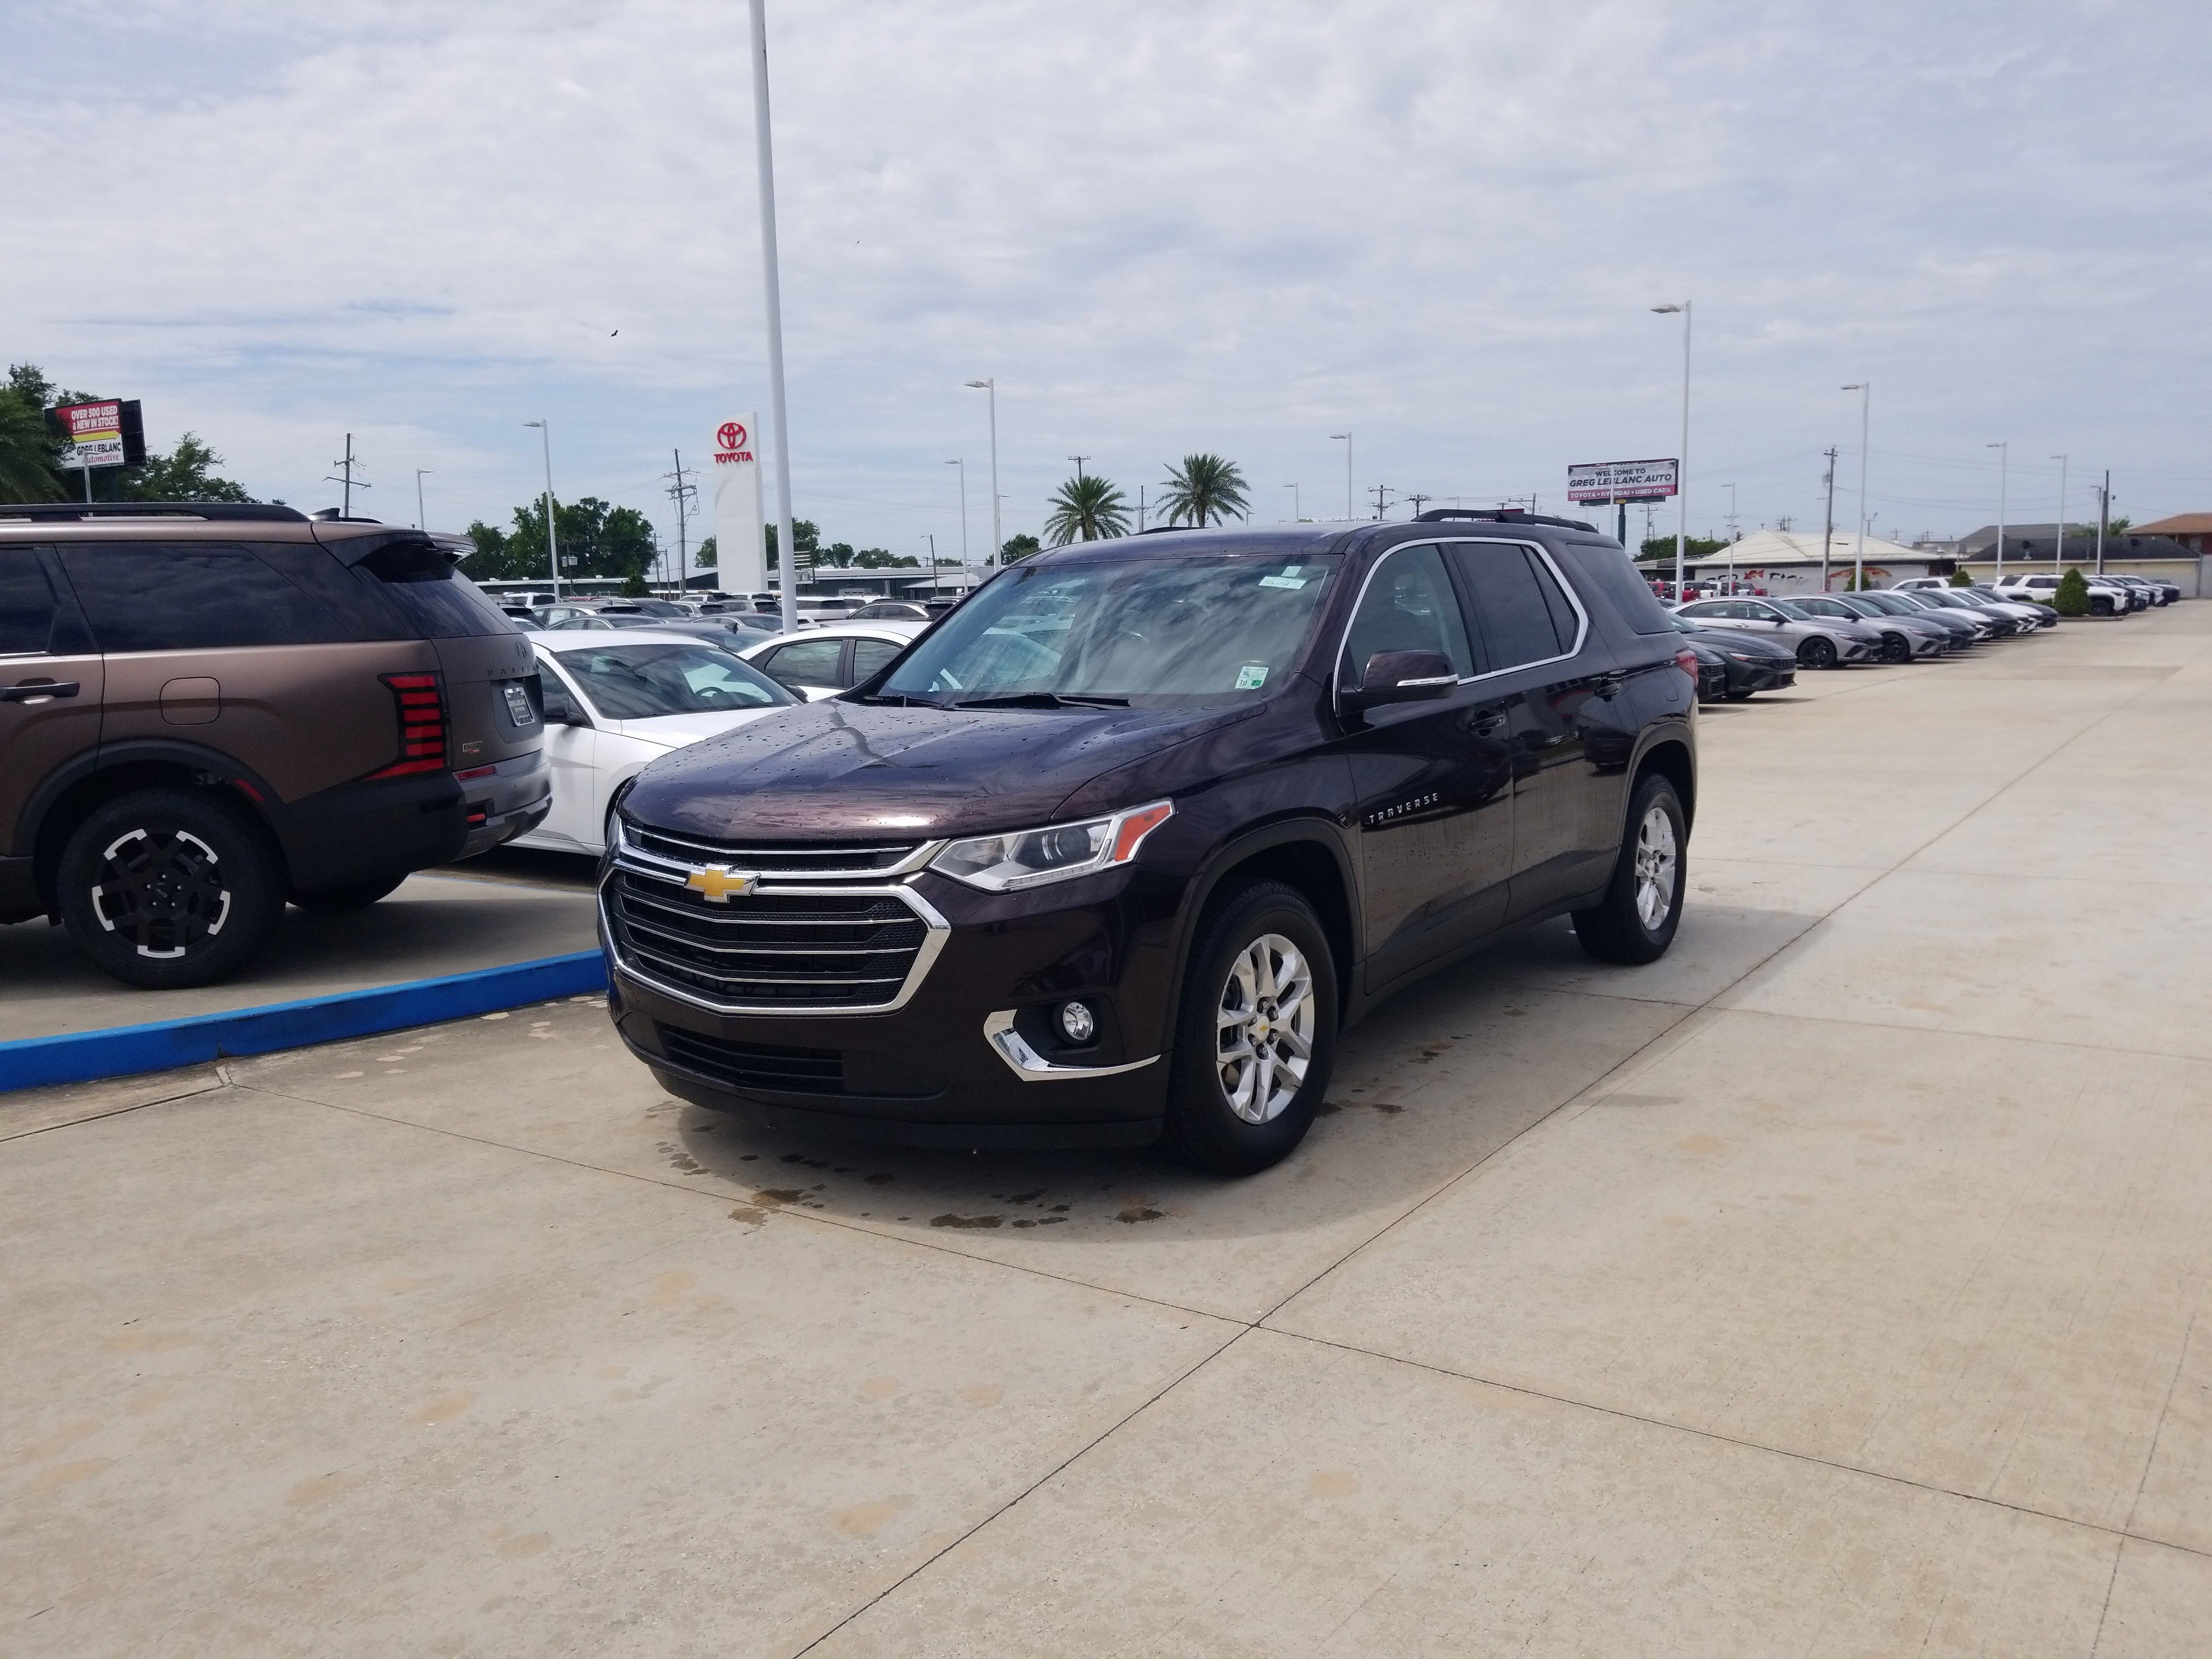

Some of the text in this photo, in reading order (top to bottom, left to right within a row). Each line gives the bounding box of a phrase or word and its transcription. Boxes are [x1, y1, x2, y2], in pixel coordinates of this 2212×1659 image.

[71, 405, 118, 420] OVER 500 USED
[77, 419, 91, 430] NEW
[91, 418, 97, 427] IN
[98, 415, 119, 427] STOCK!
[94, 442, 121, 453] LEBLANC
[714, 451, 753, 464] TOYOTA
[1570, 478, 1595, 487] GREG
[1645, 473, 1672, 483] AUTO
[1369, 793, 1438, 824] TRAVERSE
